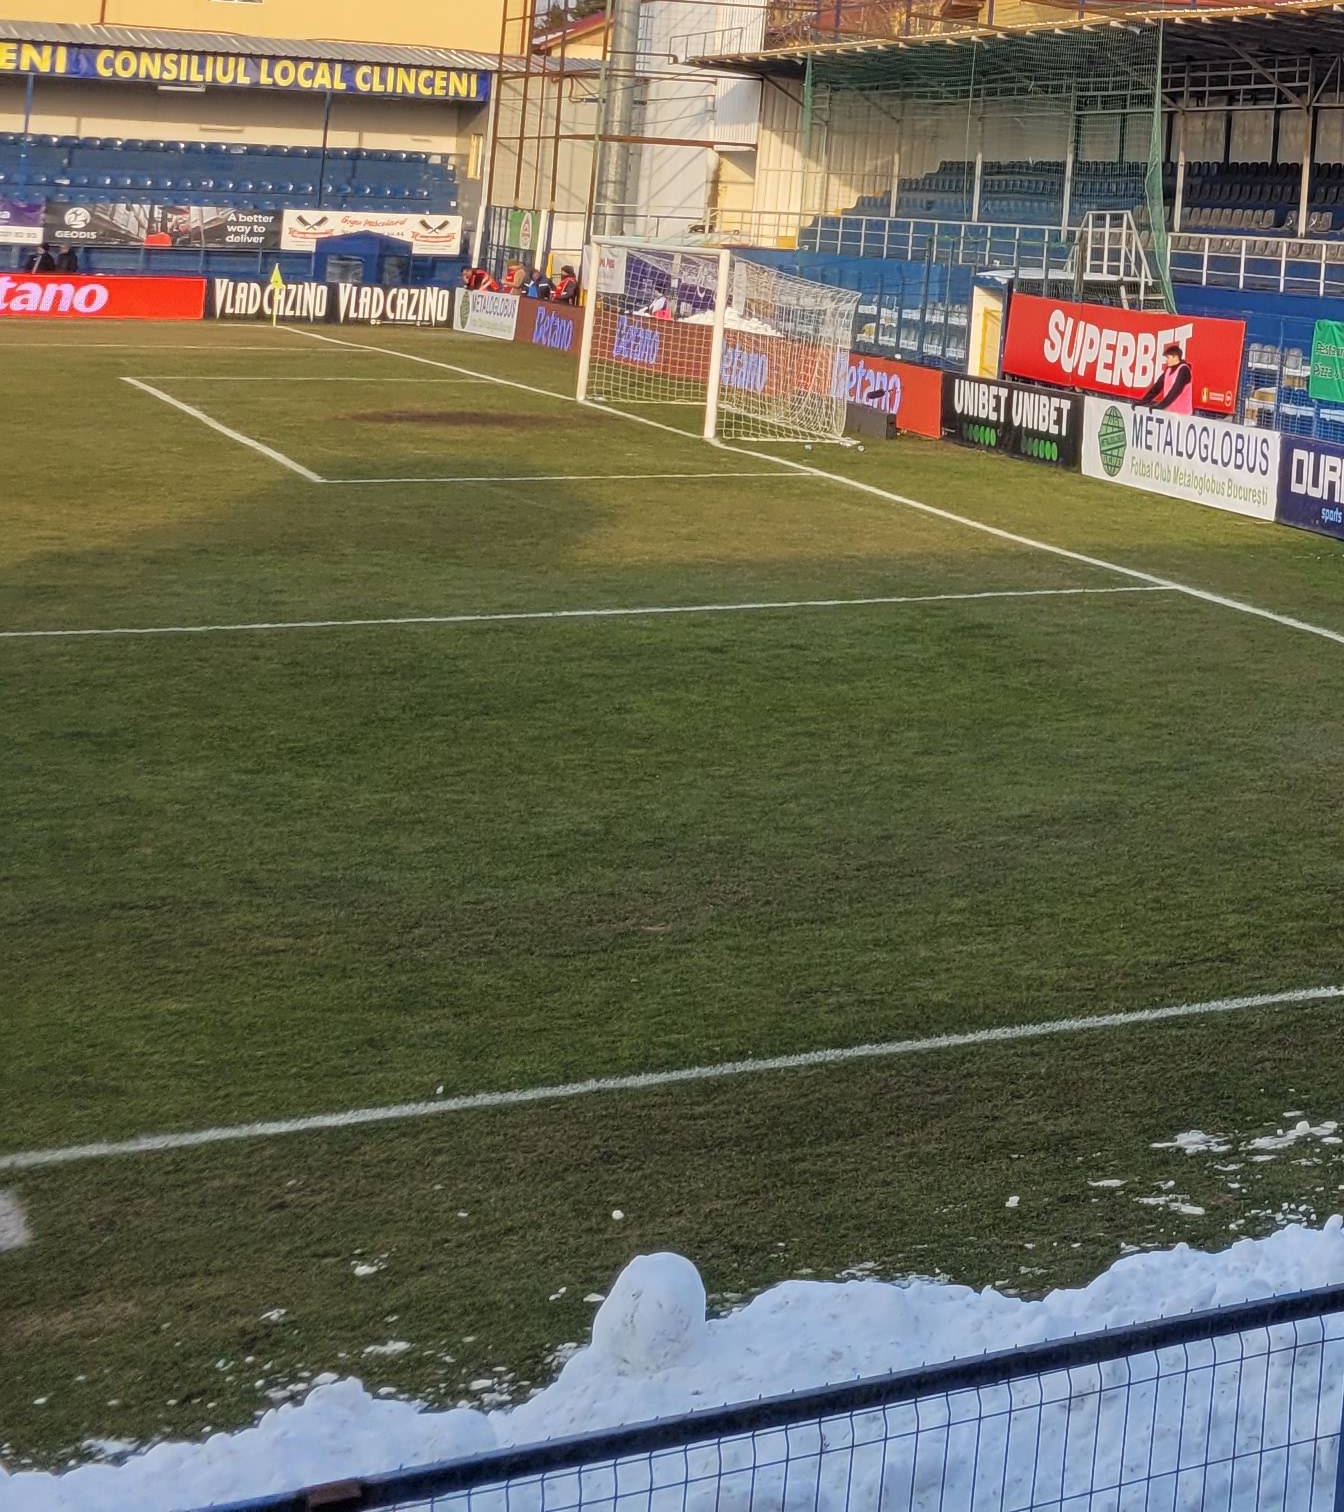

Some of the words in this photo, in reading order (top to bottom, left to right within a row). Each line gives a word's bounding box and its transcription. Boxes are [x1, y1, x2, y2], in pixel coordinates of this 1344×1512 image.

[96, 49, 249, 84] CONSILIUL
[260, 59, 346, 90] LOCAL
[355, 65, 478, 98] CLINCENI
[55, 230, 97, 240] GEODIS
[225, 233, 265, 244] deliver
[226, 225, 251, 235] way
[253, 224, 266, 233] to
[227, 213, 239, 222] A
[240, 213, 274, 223] better
[215, 278, 261, 319] VLAD
[263, 282, 328, 323] CAZINO
[339, 283, 384, 324] VLAD
[386, 287, 450, 327] CAZINO
[533, 306, 574, 351] Betano
[1044, 309, 1194, 388] SUPERBET
[720, 338, 768, 393] etano
[954, 379, 1008, 422] UNIBET
[1012, 390, 1071, 436] UNIBET
[1131, 413, 1270, 476] METALOGLOBUS
[1130, 456, 1153, 478] Fotbal
[1154, 461, 1171, 483] Club
[1172, 465, 1226, 496] Metaloglobus
[1321, 506, 1343, 525] sports
